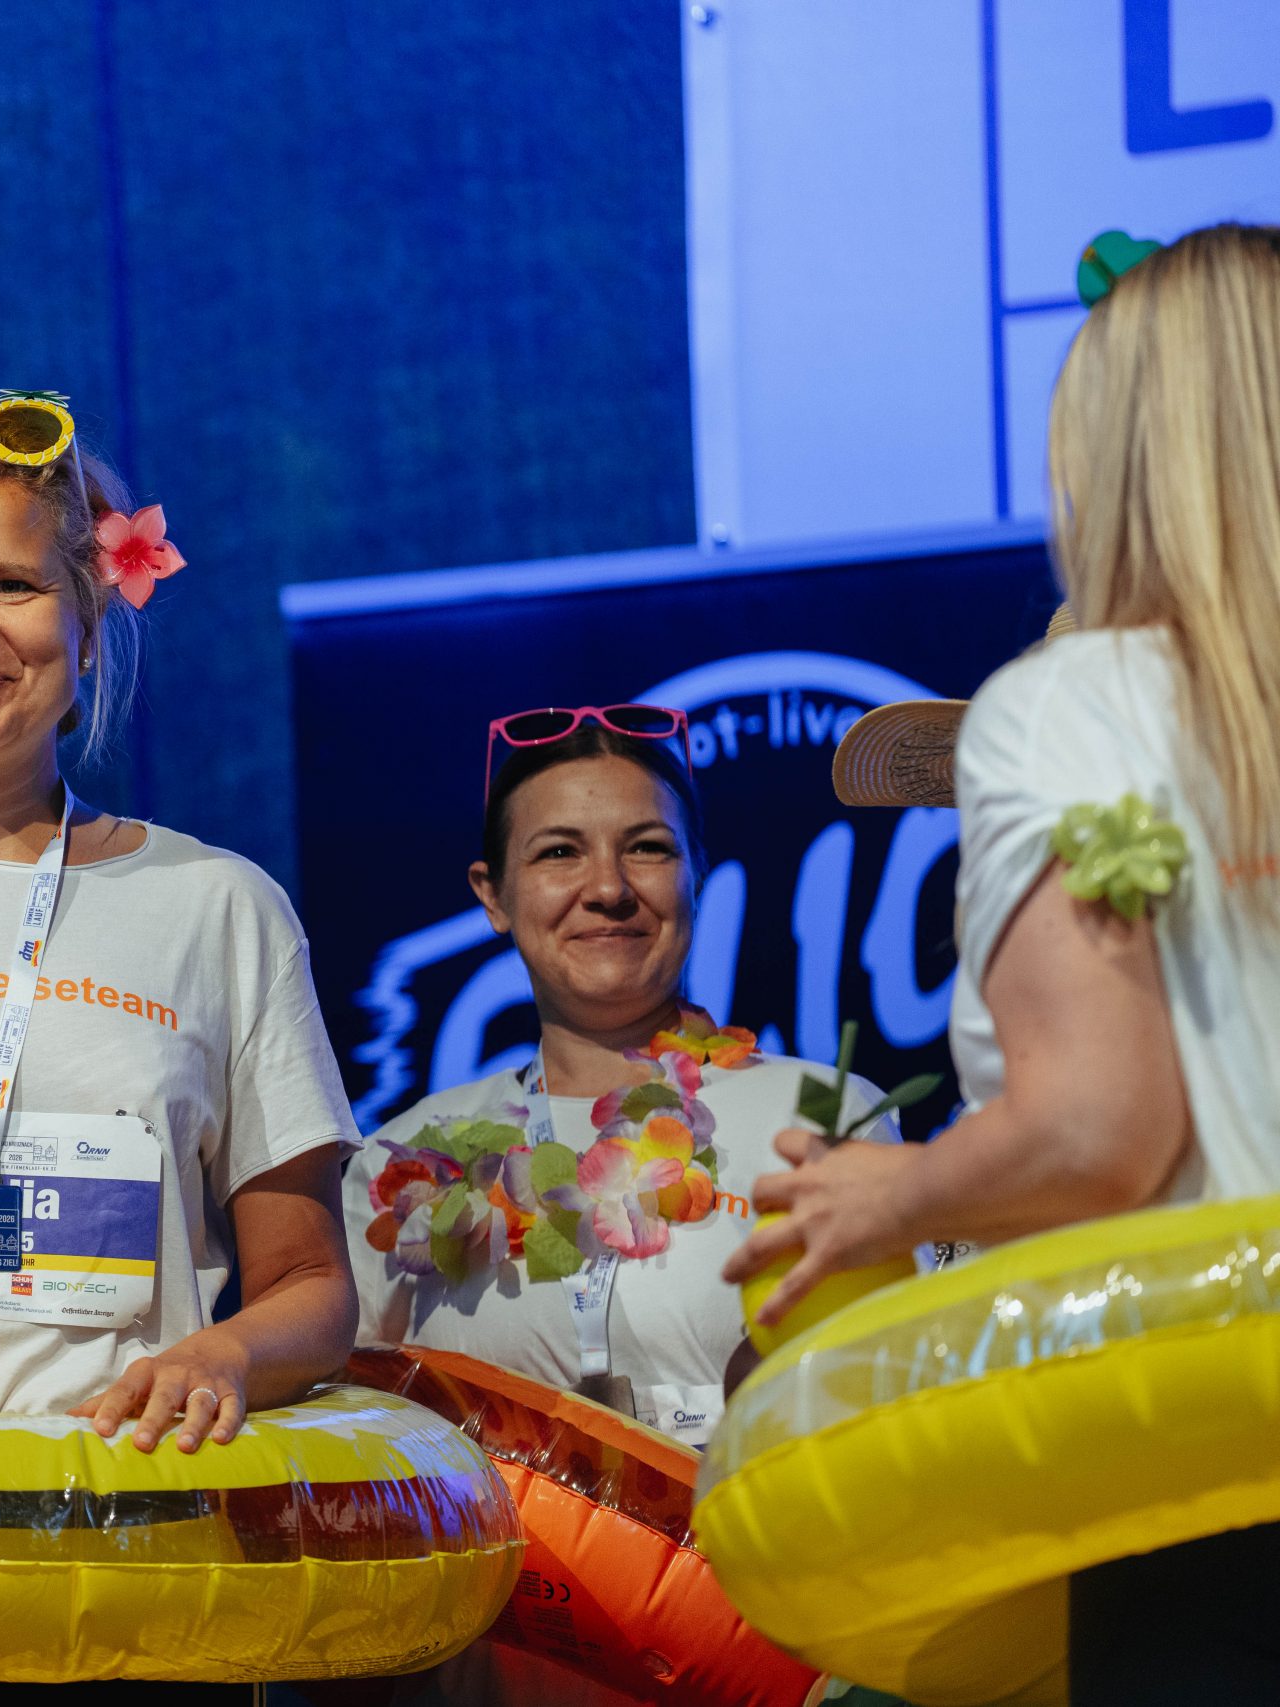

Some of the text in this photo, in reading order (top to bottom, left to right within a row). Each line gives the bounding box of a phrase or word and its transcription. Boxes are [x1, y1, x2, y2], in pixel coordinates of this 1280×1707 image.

[19, 940, 35, 962] dm
[8, 1154, 23, 1162] 2026
[10, 1179, 60, 1220] ia
[3, 1259, 19, 1267] ZIEL!
[42, 1281, 117, 1295] BIONTECH
